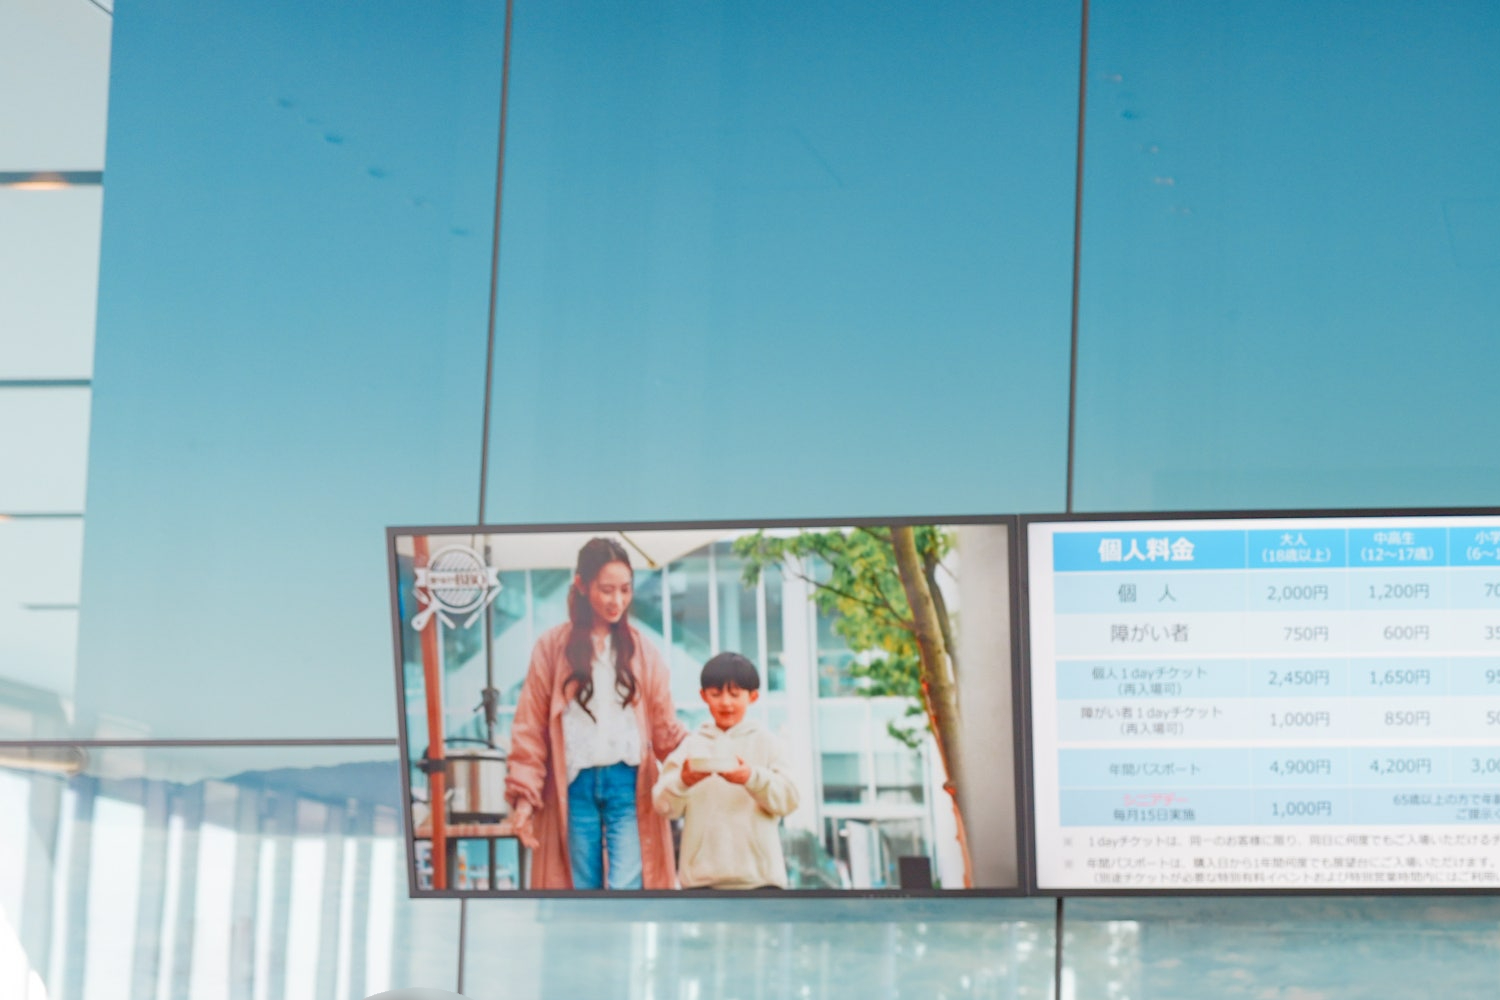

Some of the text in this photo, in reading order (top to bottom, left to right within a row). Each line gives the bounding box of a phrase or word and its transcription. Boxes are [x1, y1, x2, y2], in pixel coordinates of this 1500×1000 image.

[1280, 533, 1307, 546] 大人
[1374, 532, 1415, 545] 中高生
[1098, 537, 1195, 563] 個人料金
[1267, 586, 1328, 602] 2,000円
[1369, 584, 1430, 600] 1,200円
[1111, 624, 1189, 643] 障がい者
[1284, 627, 1328, 641] 750円
[1384, 625, 1430, 641] 600円
[1268, 670, 1330, 687] 2,450円
[1369, 669, 1430, 686] 1,650円
[1271, 711, 1330, 728] 1,000円
[1384, 710, 1430, 726] 850円
[1109, 763, 1200, 777] 年間パスポート
[1269, 759, 1331, 776] 4,900円
[1370, 758, 1431, 775] 4,200円
[1272, 801, 1332, 818] 1,000円
